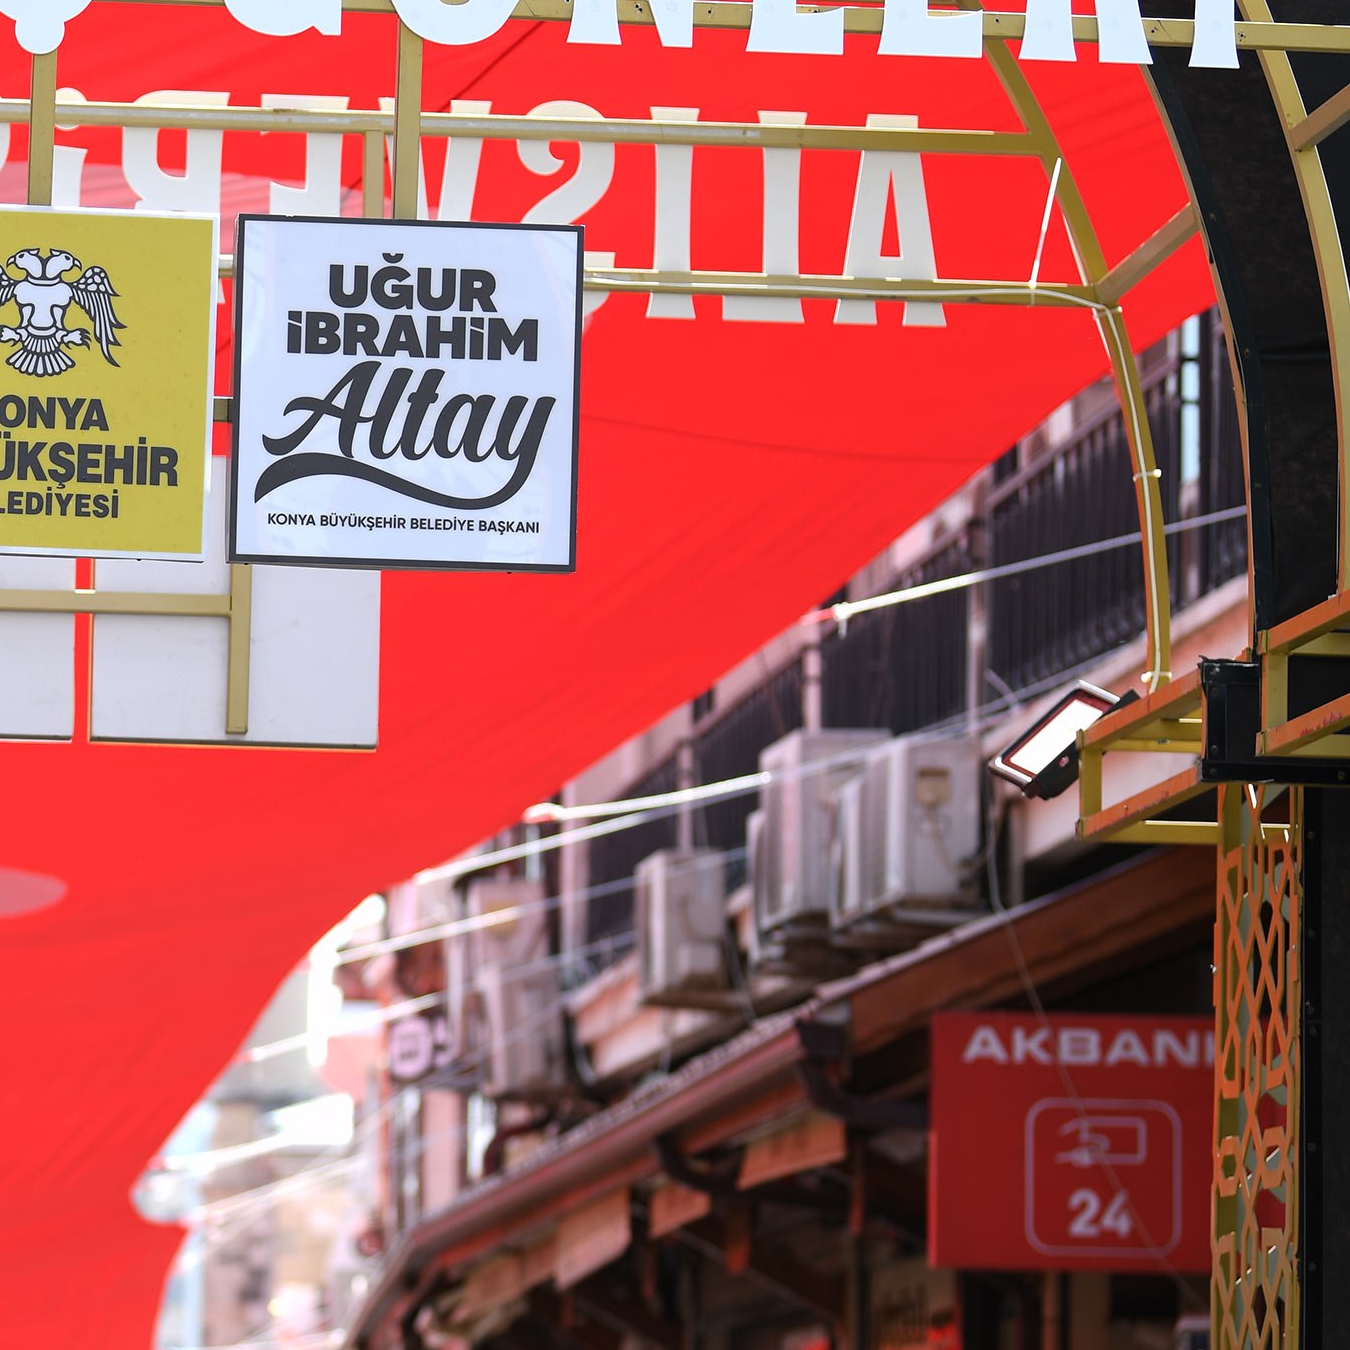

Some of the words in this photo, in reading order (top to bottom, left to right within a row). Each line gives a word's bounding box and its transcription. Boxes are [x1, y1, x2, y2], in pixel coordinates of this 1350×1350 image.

[329, 252, 498, 313] UĞUR
[254, 360, 557, 511] Altay
[267, 512, 316, 527] KONYA
[319, 513, 407, 532] BÜYÜKŞEHİR
[410, 516, 475, 532] BELEDİYE
[478, 520, 540, 536] BAŞKANI
[1068, 1188, 1131, 1238] 24
